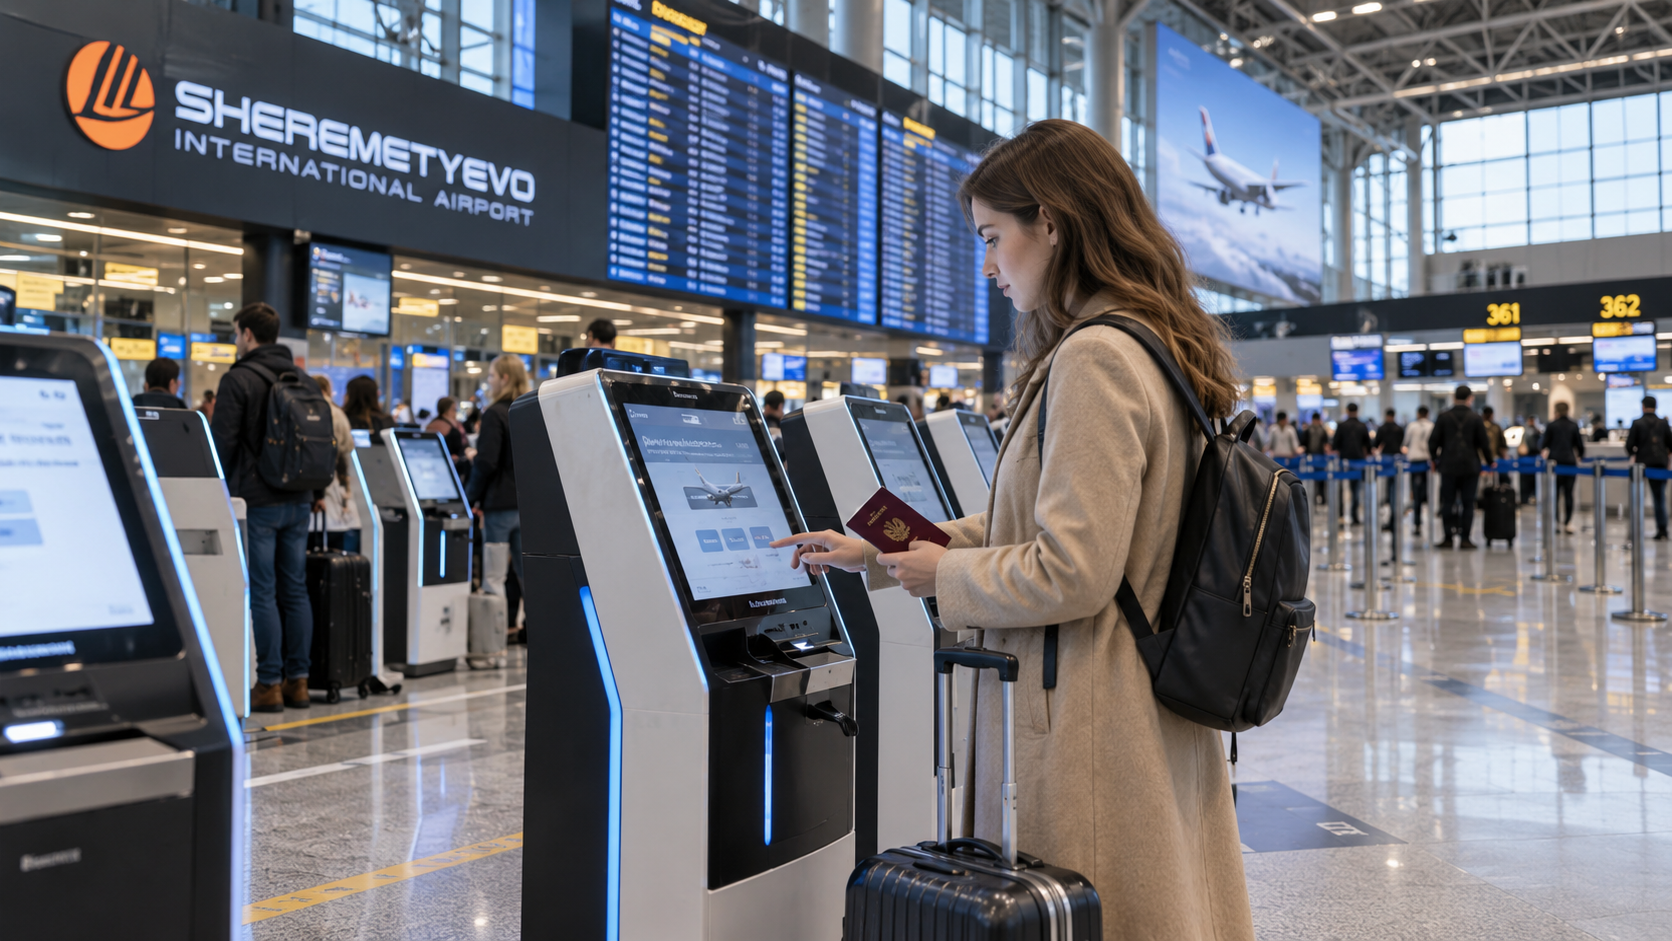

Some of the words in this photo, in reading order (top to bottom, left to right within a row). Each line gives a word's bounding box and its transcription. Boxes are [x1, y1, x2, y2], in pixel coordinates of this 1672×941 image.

[175, 80, 535, 203] SHEREMETYEVO
[175, 128, 423, 203] INTERNATIONAL
[434, 190, 534, 227] AIRPORT
[1486, 302, 1520, 326] 361
[1600, 294, 1641, 319] 362
